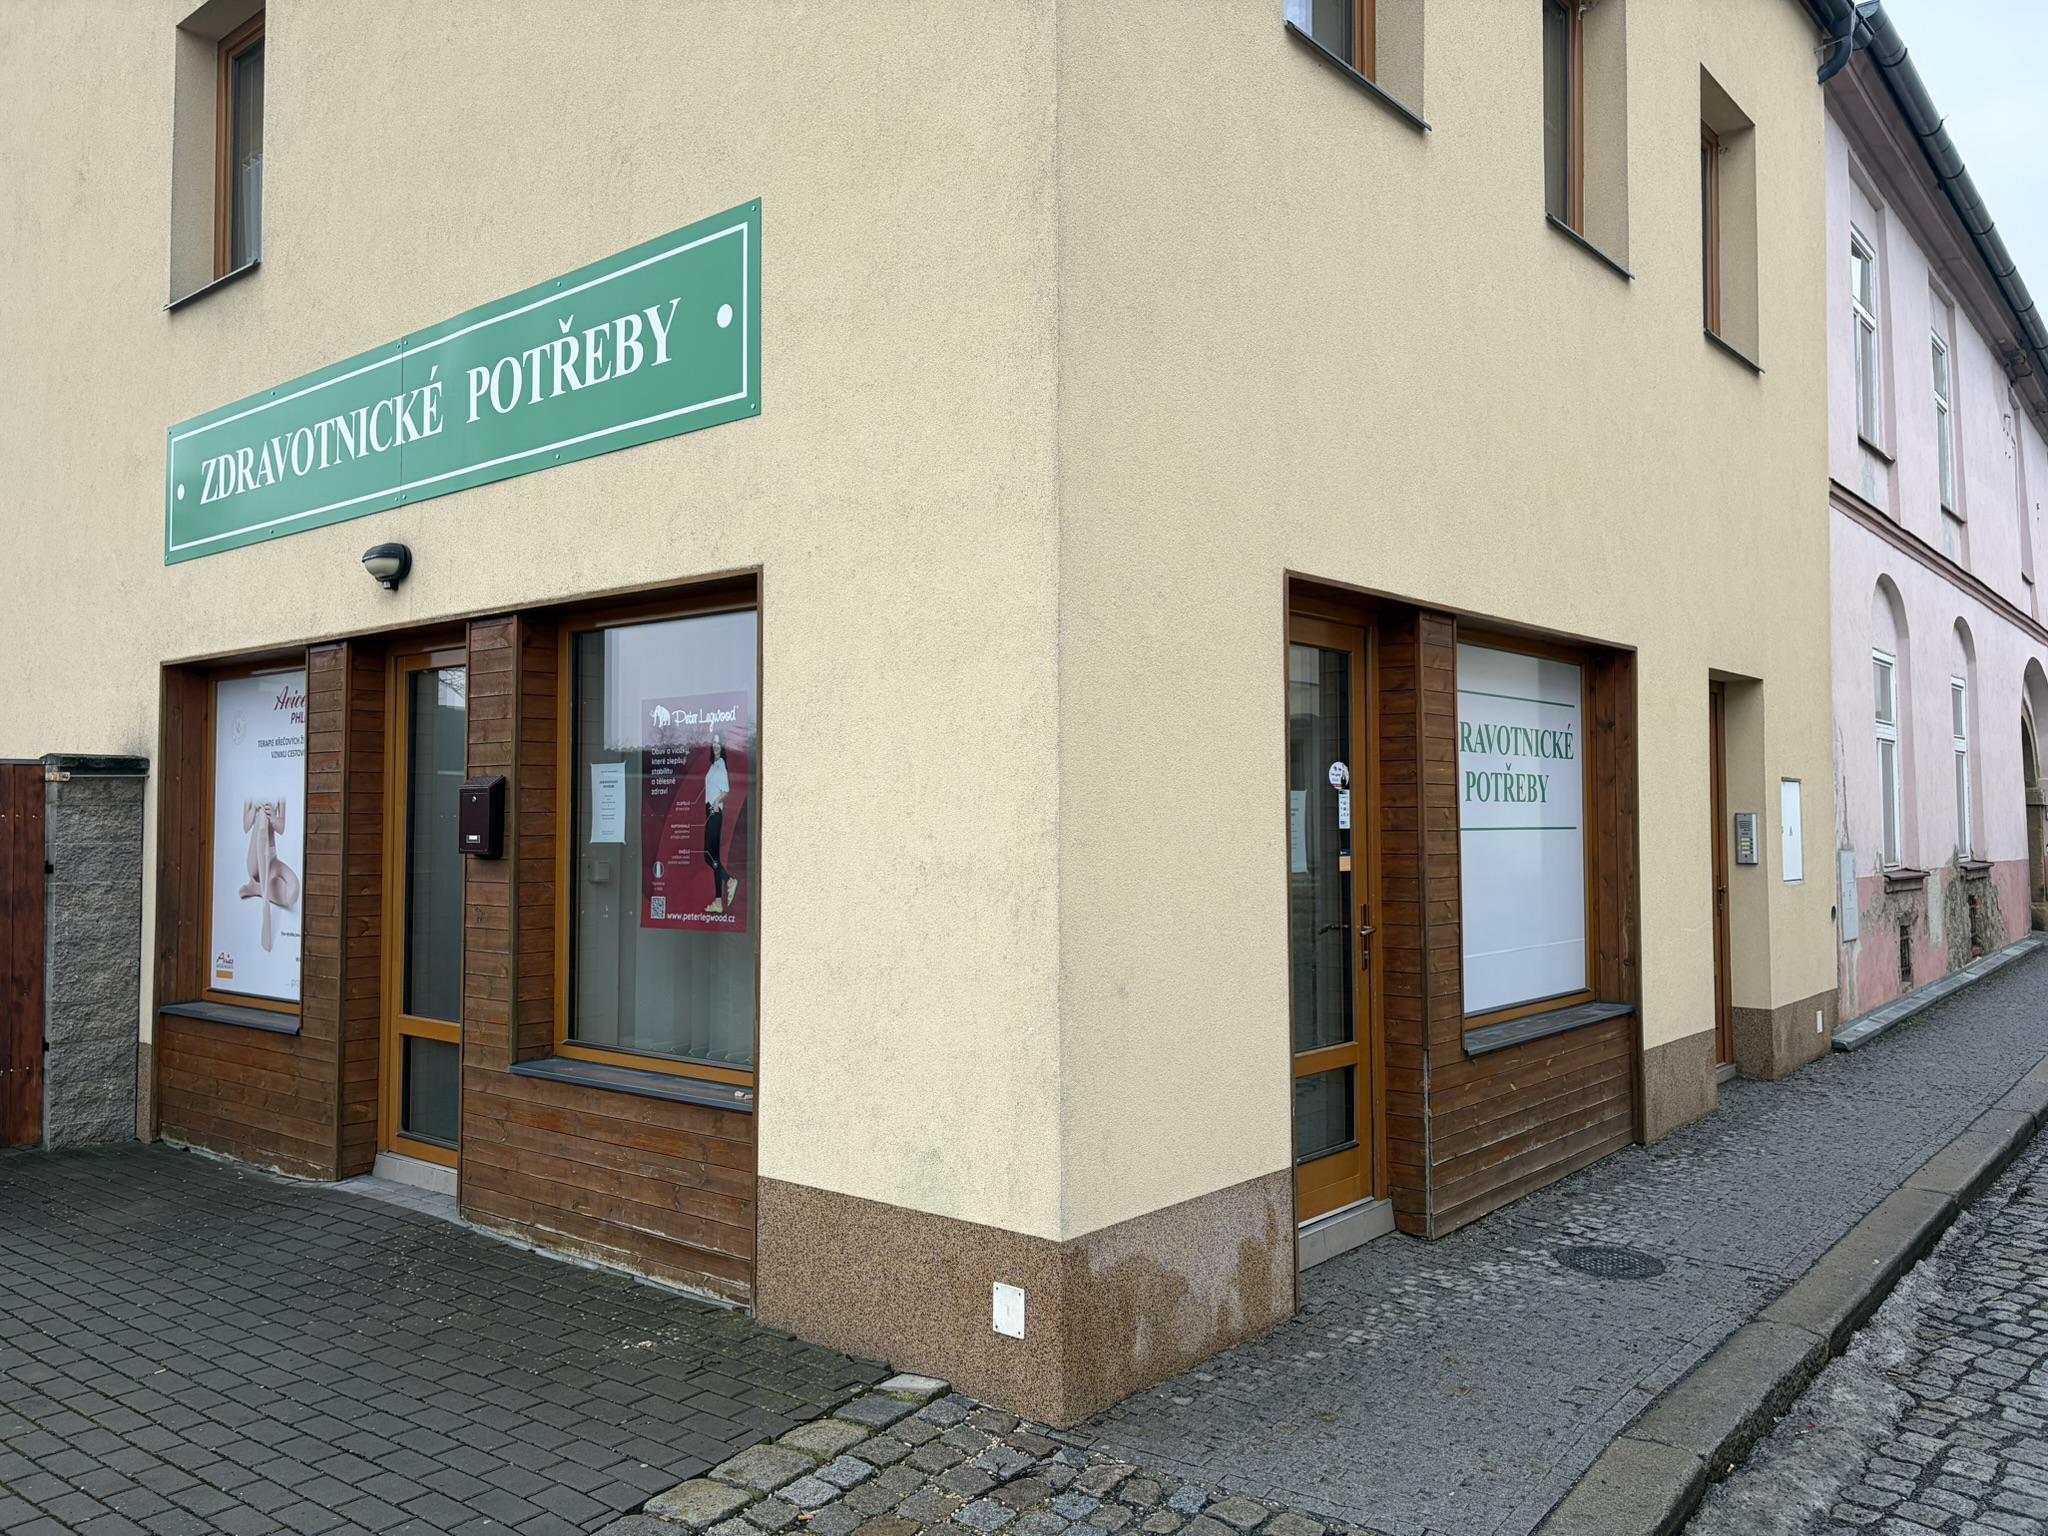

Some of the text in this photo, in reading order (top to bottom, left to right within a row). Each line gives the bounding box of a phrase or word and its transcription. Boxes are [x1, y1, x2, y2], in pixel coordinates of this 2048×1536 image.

[200, 297, 684, 505] ZDRAVOTNICKÉ POTŘEBY
[671, 705, 737, 733] Peter Legwood
[1460, 721, 1574, 760] RAVOTNICKÉ
[1465, 762, 1550, 803] POTŘEBY
[667, 912, 736, 923] www.peterlegwood.cz
